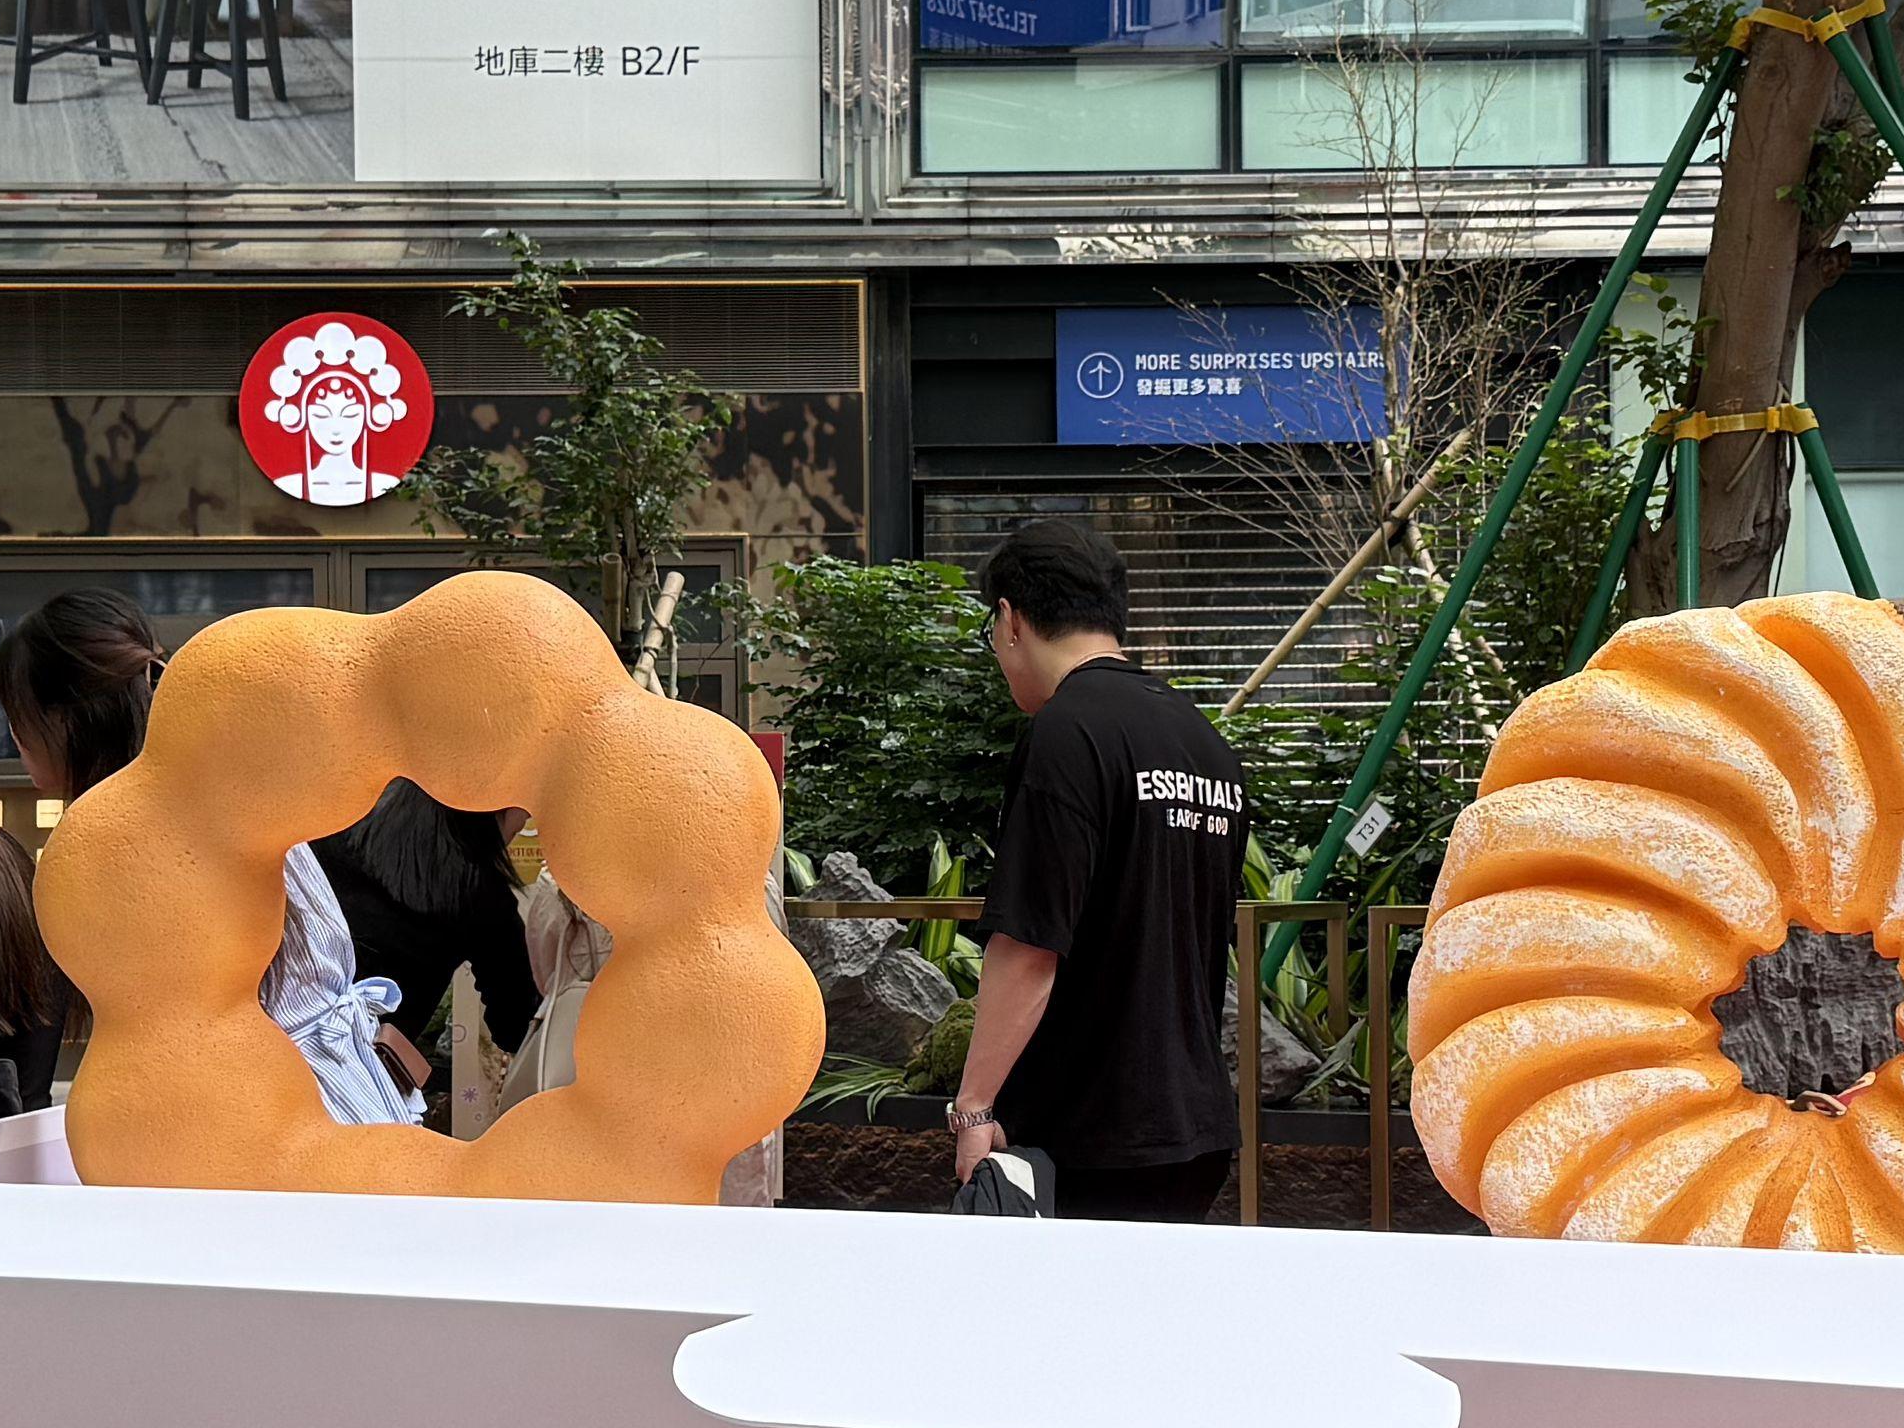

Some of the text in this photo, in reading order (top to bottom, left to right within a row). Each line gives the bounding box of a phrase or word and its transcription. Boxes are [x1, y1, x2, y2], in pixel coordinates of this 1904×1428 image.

[473, 42, 700, 80] 地庫二樓 B2/F
[1135, 354, 1181, 371] MORE
[1188, 353, 1294, 371] SURPRISES
[1355, 815, 1381, 841] T31
